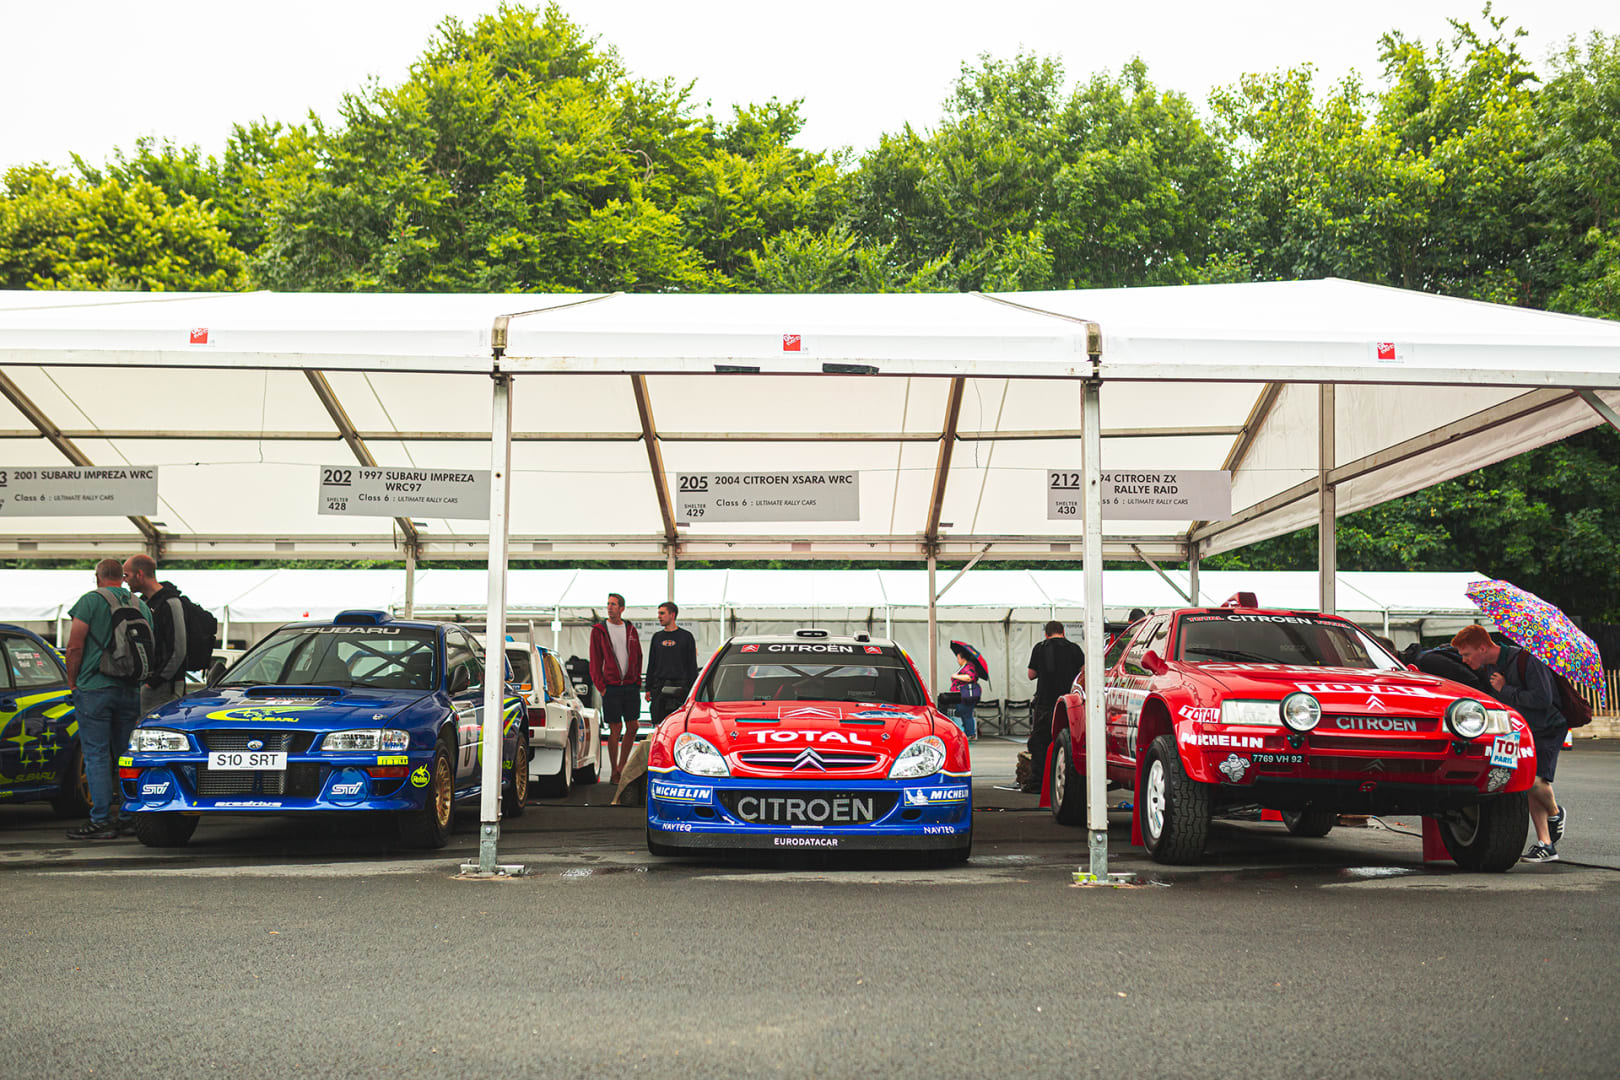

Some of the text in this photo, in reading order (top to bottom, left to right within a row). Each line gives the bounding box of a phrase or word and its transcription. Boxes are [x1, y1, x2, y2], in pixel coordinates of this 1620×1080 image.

[14, 470, 153, 480] 2001 SUBARU IMPREZA WRC
[323, 470, 352, 483] 202
[358, 470, 474, 482] 1997 SUBARU IMPREZA
[714, 475, 853, 484] 2004 CITROEN XSARA WRC
[1051, 474, 1080, 486] 212
[1100, 474, 1176, 483] 94 CITROEN ZX
[386, 482, 422, 492] WRC97
[680, 476, 708, 489] 205
[1114, 486, 1178, 494] RALLYE RAID
[358, 494, 380, 502] Class
[328, 502, 346, 511] 428
[1058, 506, 1076, 515] 430
[686, 508, 704, 517] 429
[1227, 614, 1312, 625] CITROEN
[768, 644, 854, 653] CITROËN
[1183, 706, 1217, 722] TOTAL
[1336, 716, 1417, 732] CITROEN
[748, 729, 872, 746] TOTAL
[1181, 733, 1264, 748] MICHELIN
[216, 754, 278, 766] S10 SRT
[1252, 754, 1274, 762] 7769
[655, 785, 710, 799] MICHELIN
[738, 794, 873, 822] CITROËN
[774, 838, 838, 846] EURODATACAR
